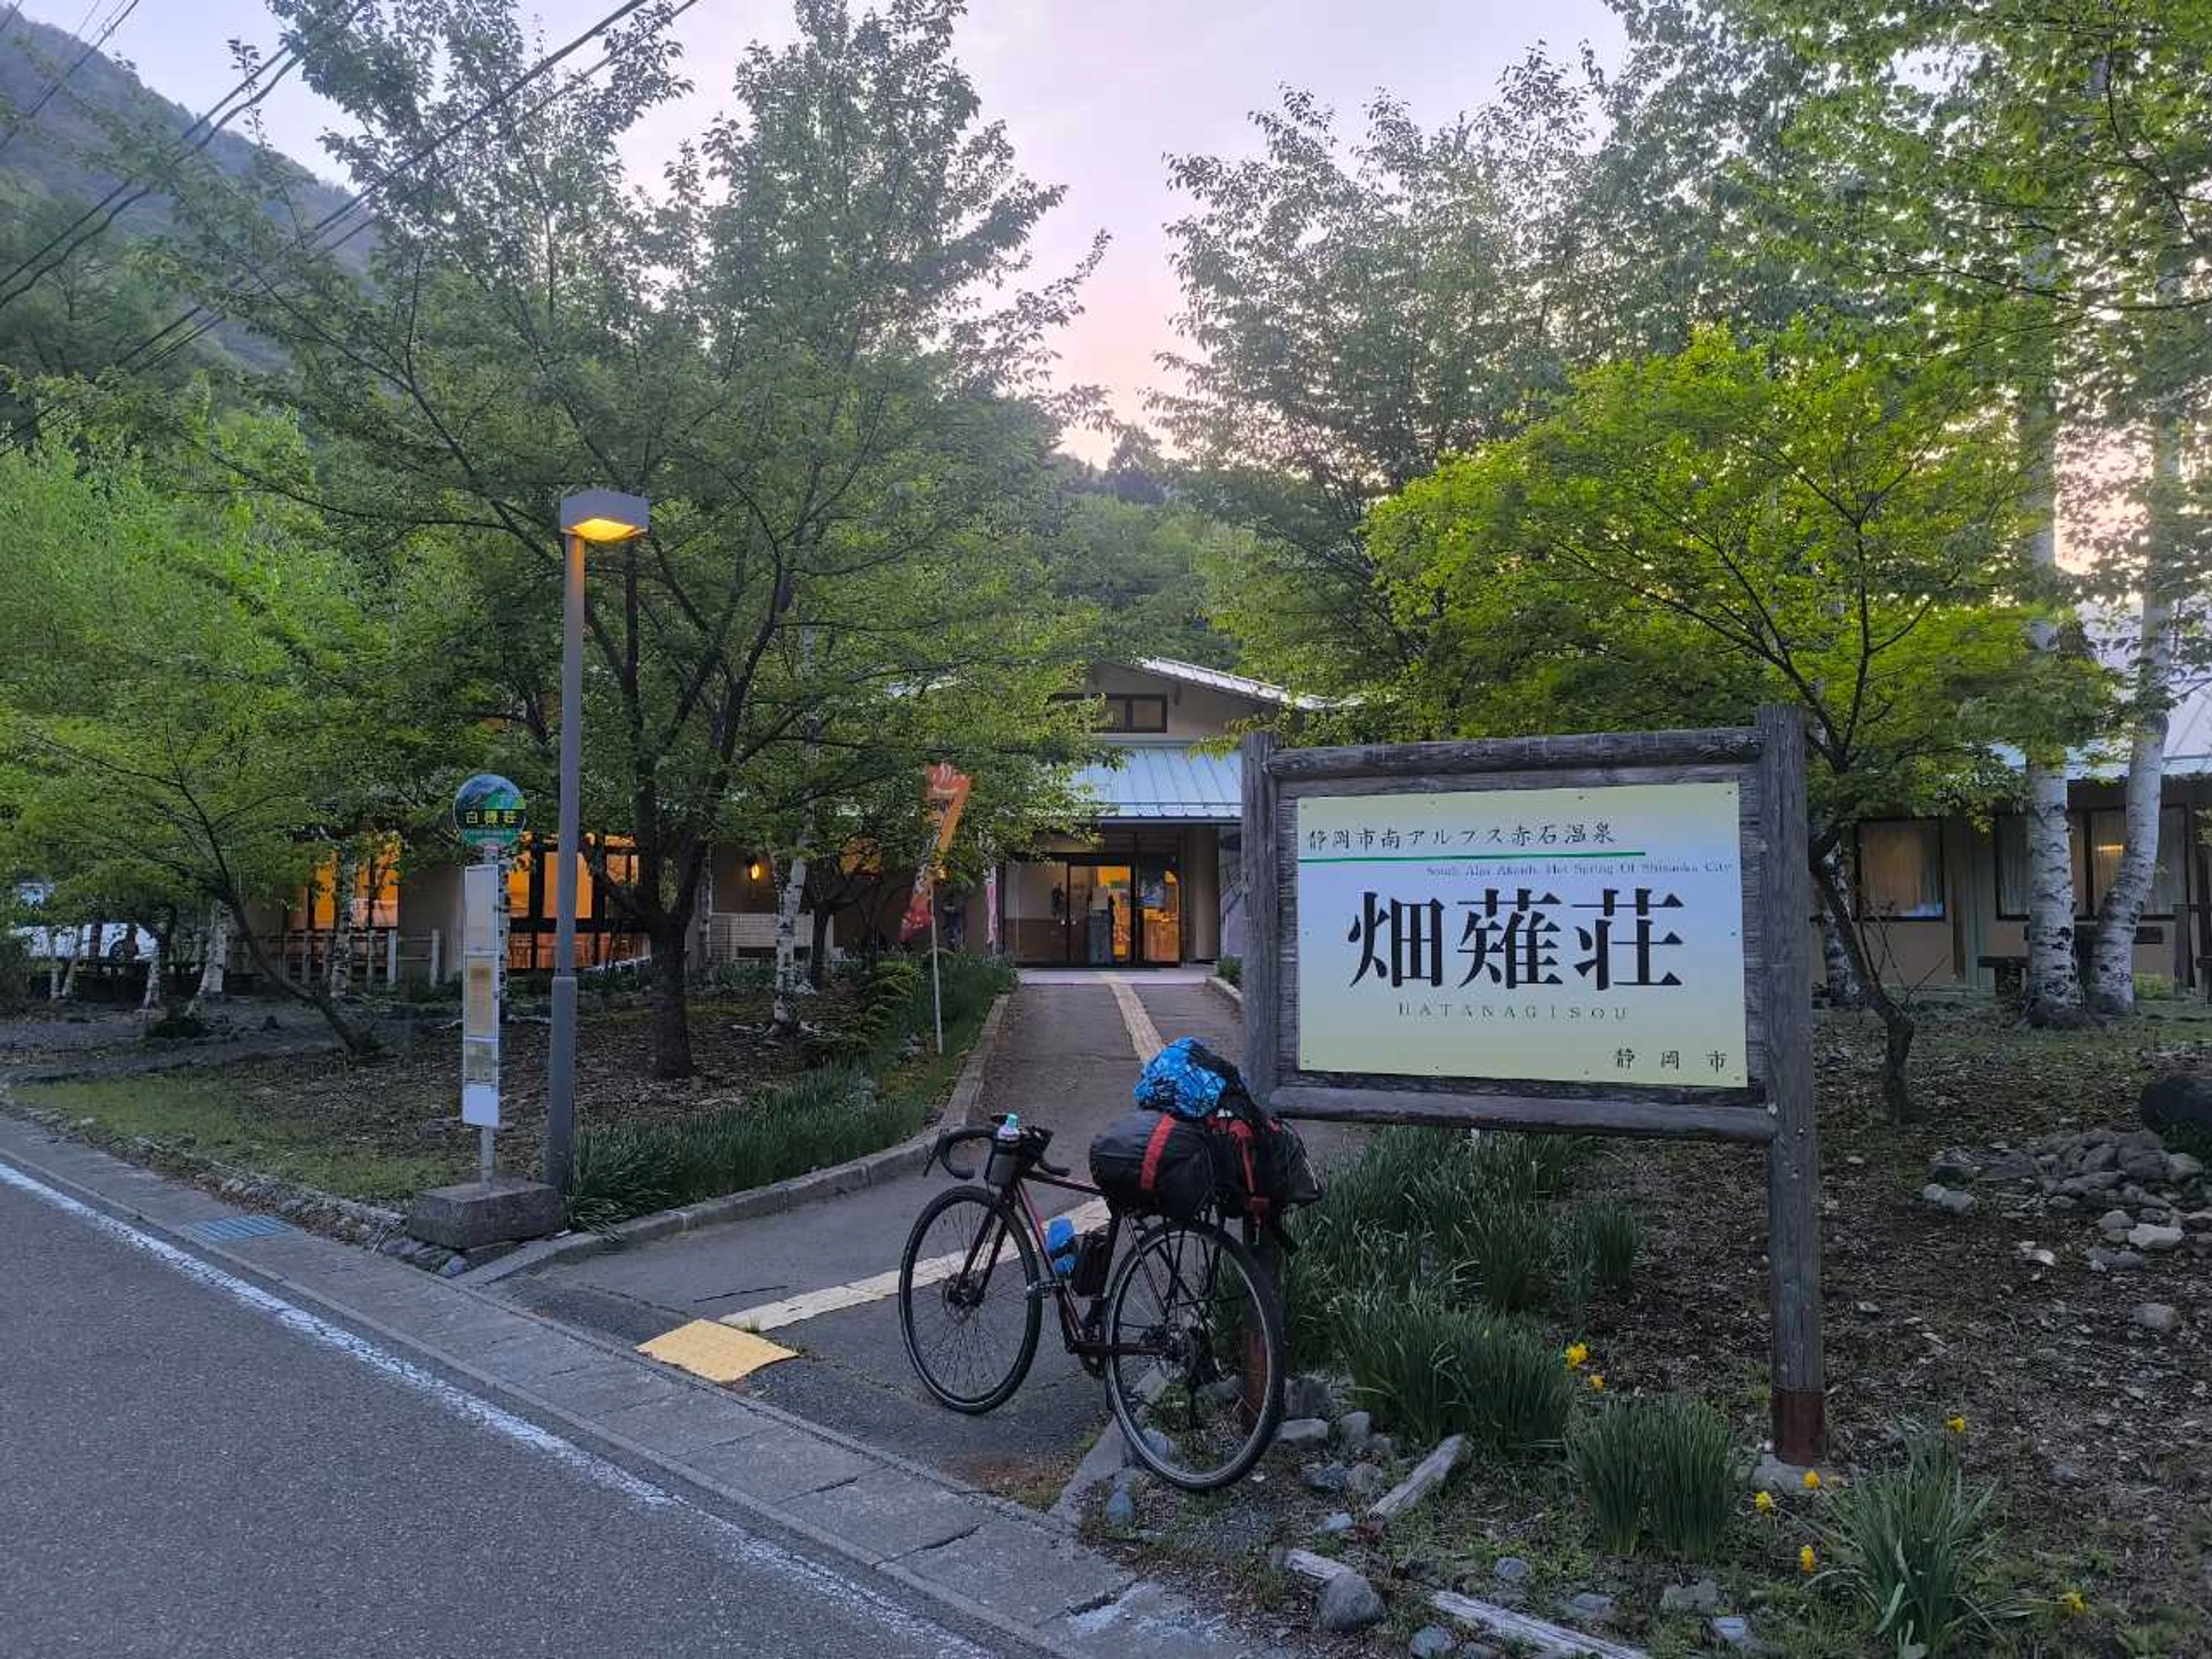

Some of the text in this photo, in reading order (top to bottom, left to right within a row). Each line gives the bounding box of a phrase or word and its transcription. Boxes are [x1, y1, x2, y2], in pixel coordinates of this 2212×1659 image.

[1347, 888, 1684, 991] 畑薙荘
[1399, 1003, 1628, 1020] HATANAGISOU
